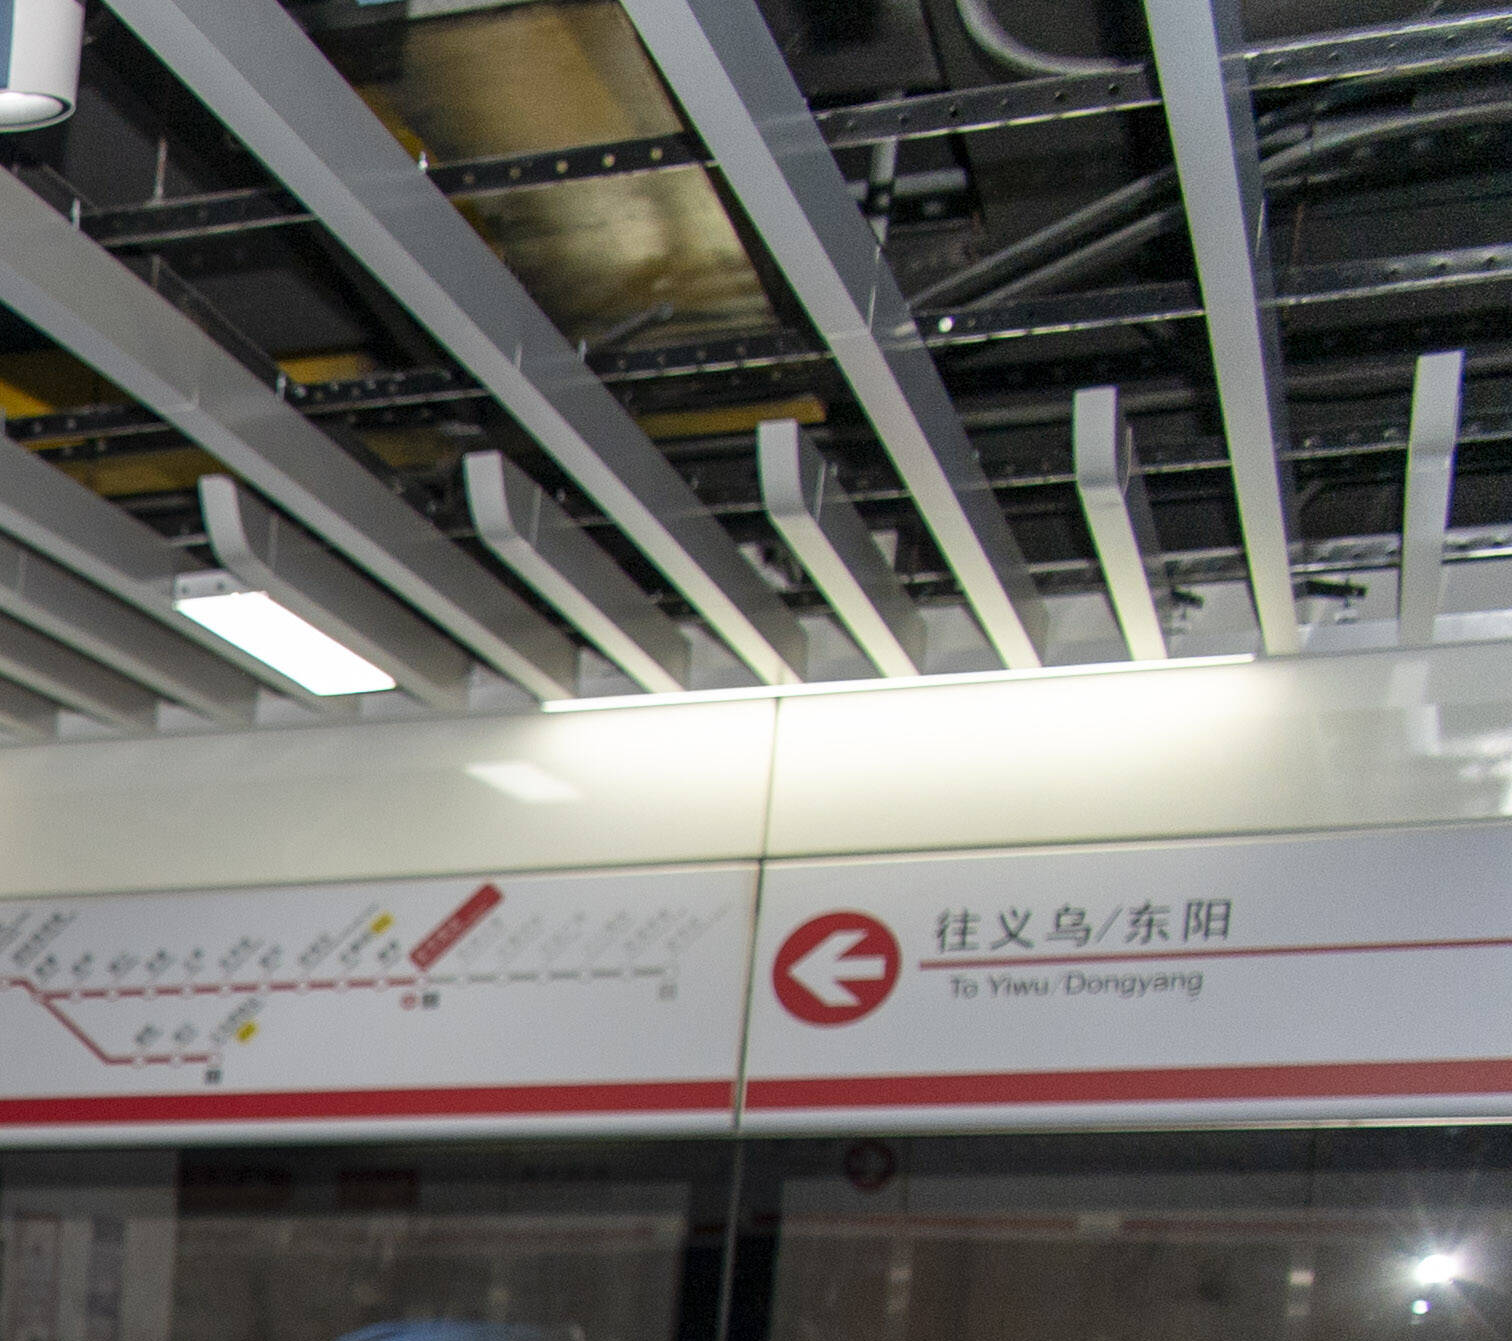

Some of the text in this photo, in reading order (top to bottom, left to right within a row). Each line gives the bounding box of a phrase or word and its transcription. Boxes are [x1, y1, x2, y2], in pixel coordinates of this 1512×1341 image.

[935, 899, 1233, 953] 往义乌/东阳
[951, 975, 979, 999] To
